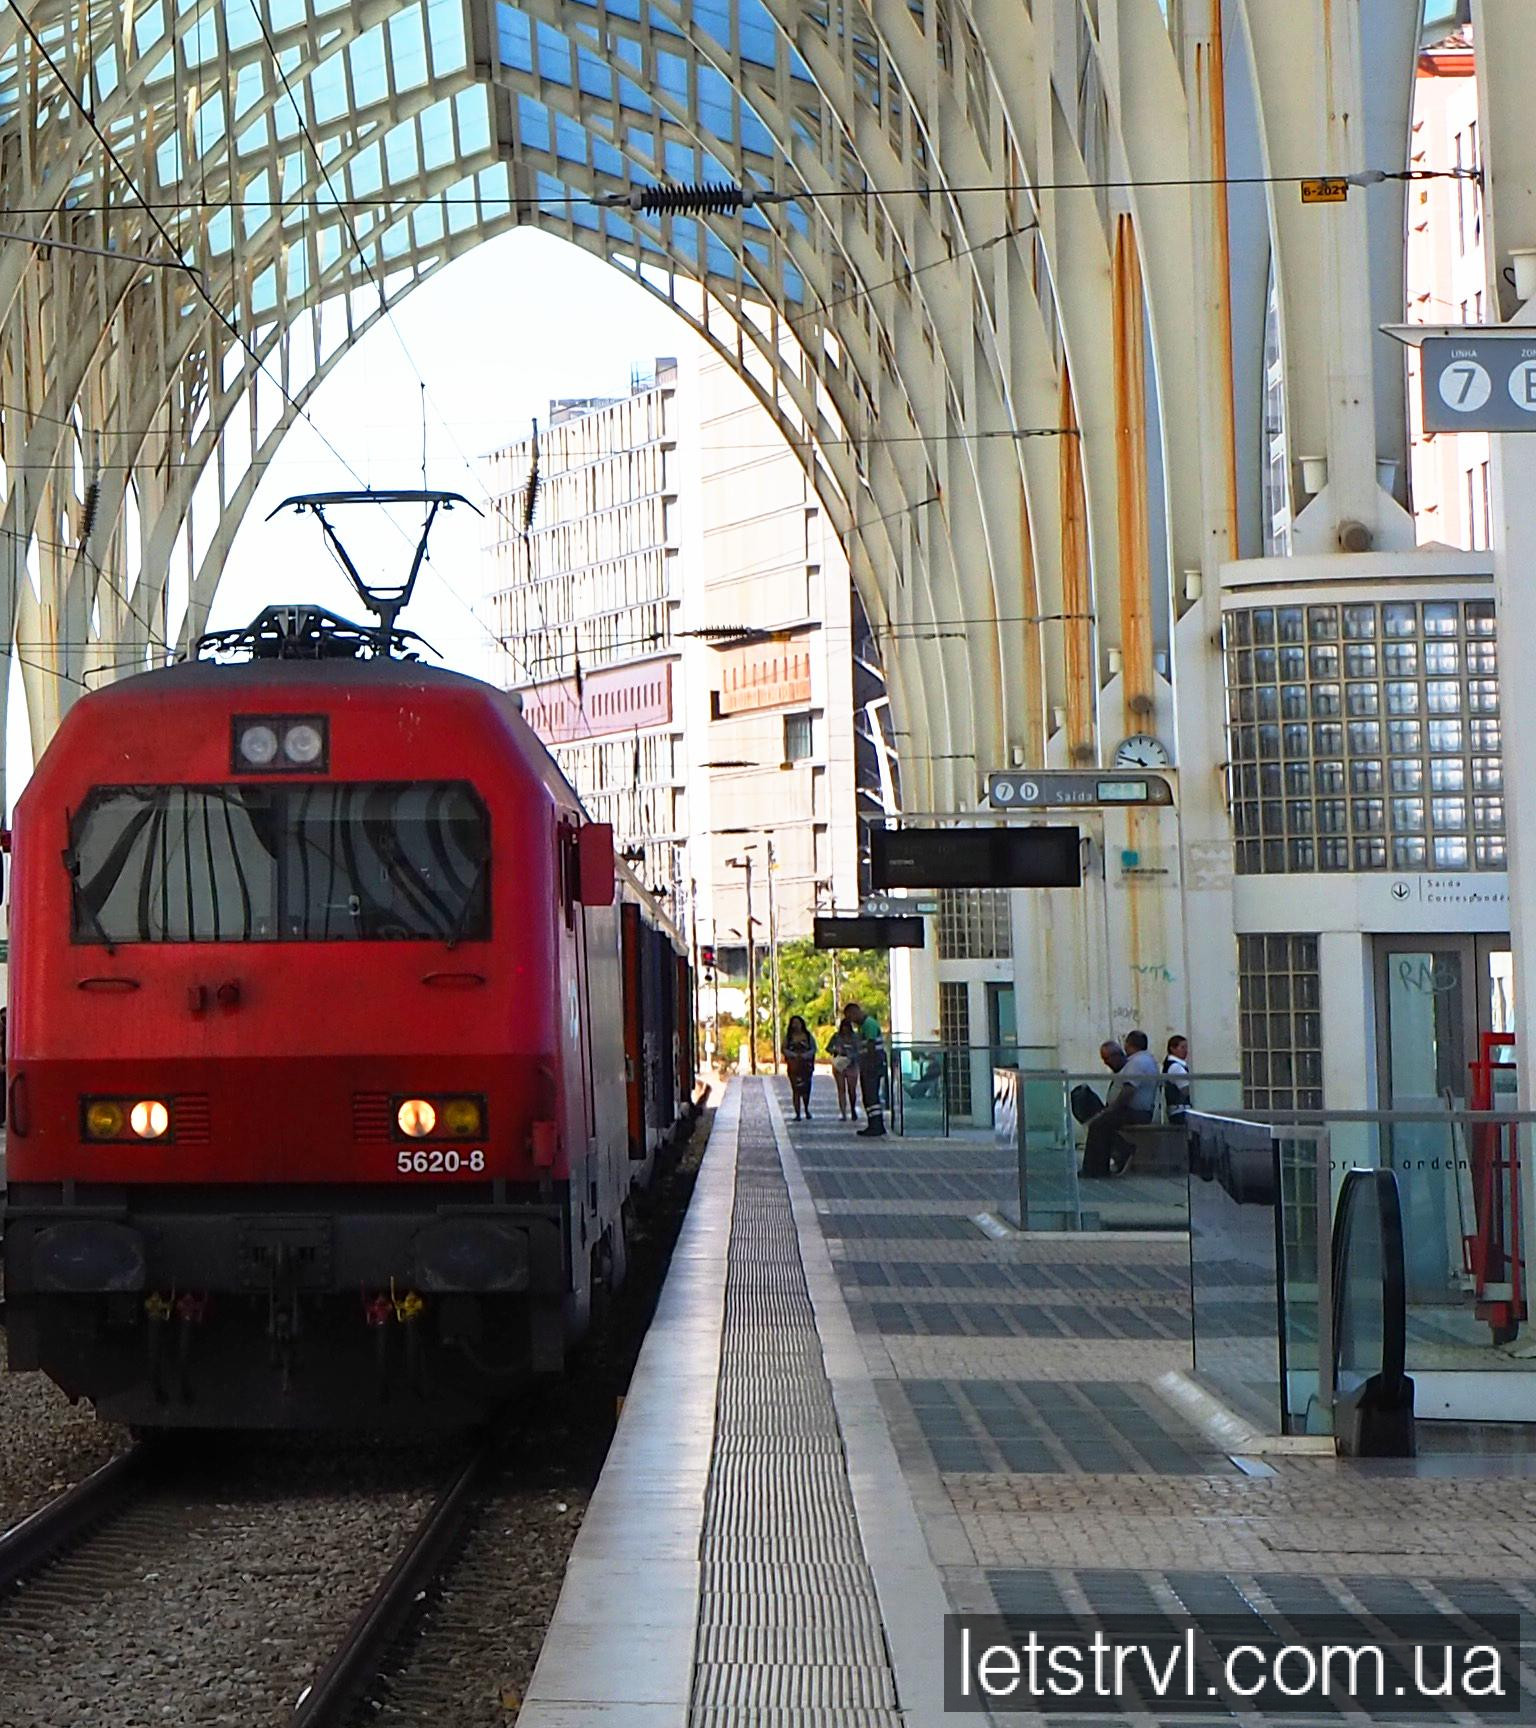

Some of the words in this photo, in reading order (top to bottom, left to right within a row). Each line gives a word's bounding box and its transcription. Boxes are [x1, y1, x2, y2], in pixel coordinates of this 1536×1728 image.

[1451, 349, 1477, 358] LINHA
[1452, 368, 1476, 404] 7
[397, 1150, 485, 1173] 5620-8
